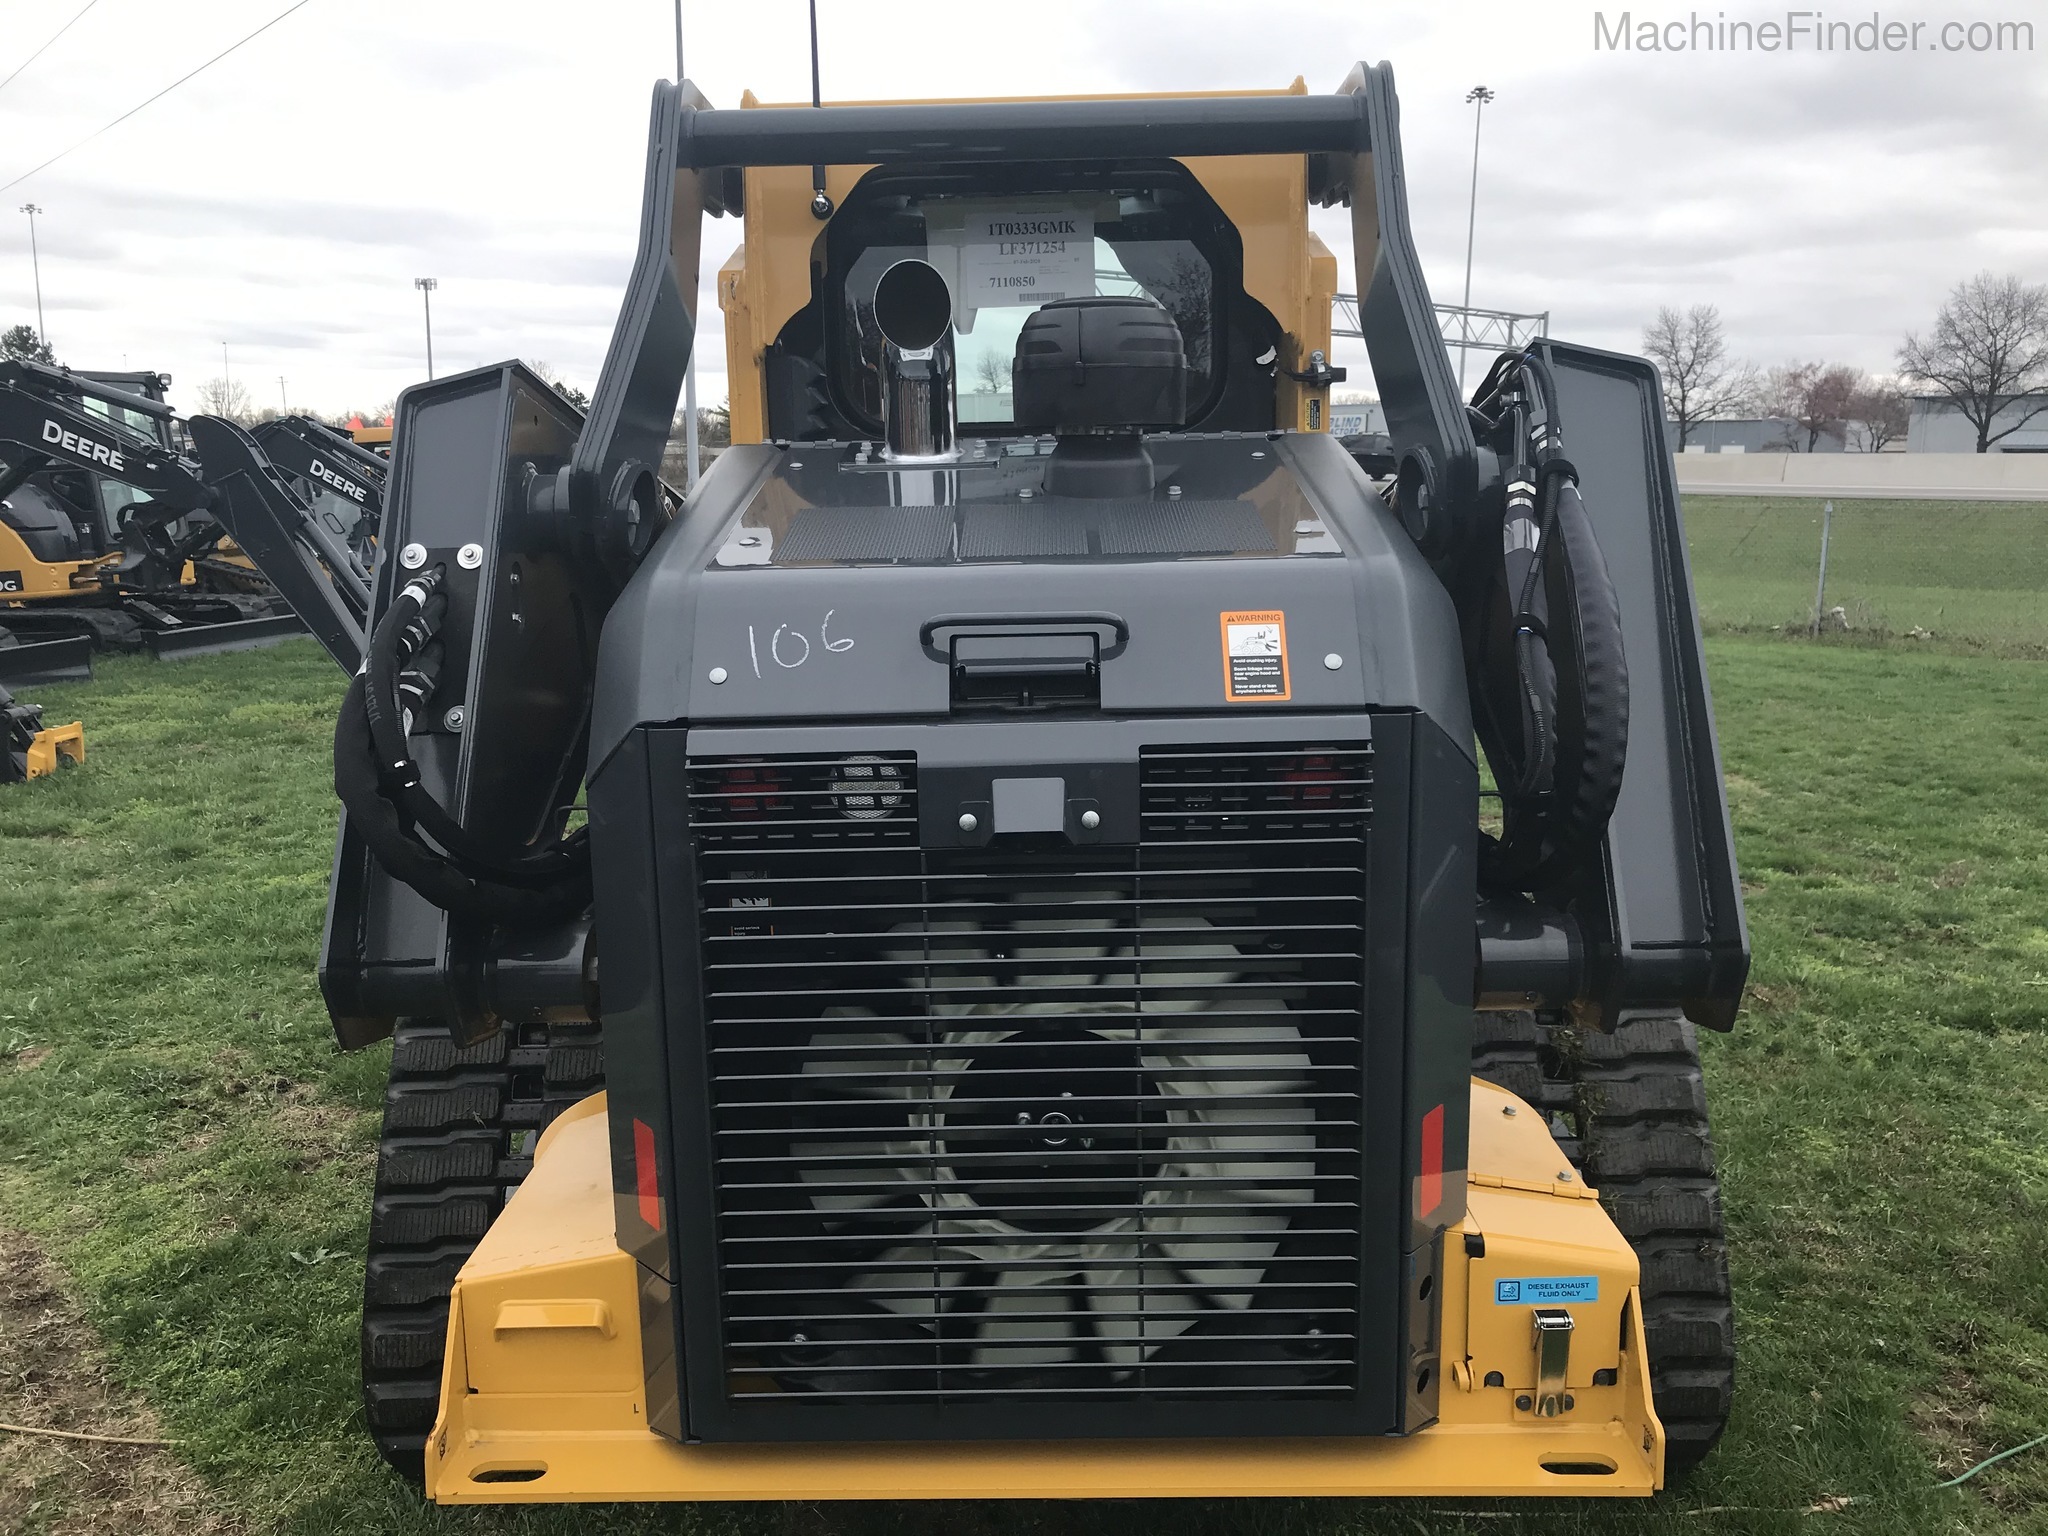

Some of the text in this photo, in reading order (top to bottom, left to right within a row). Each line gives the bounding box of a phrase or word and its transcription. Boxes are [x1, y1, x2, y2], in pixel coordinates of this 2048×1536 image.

[988, 221, 1076, 236] 1T0333GMK
[998, 240, 1066, 256] LF371254
[989, 276, 1035, 288] 7110850
[42, 419, 126, 472] DEERE
[309, 459, 367, 503] DEERE
[1236, 614, 1281, 622] WARNING
[748, 609, 855, 679] 106
